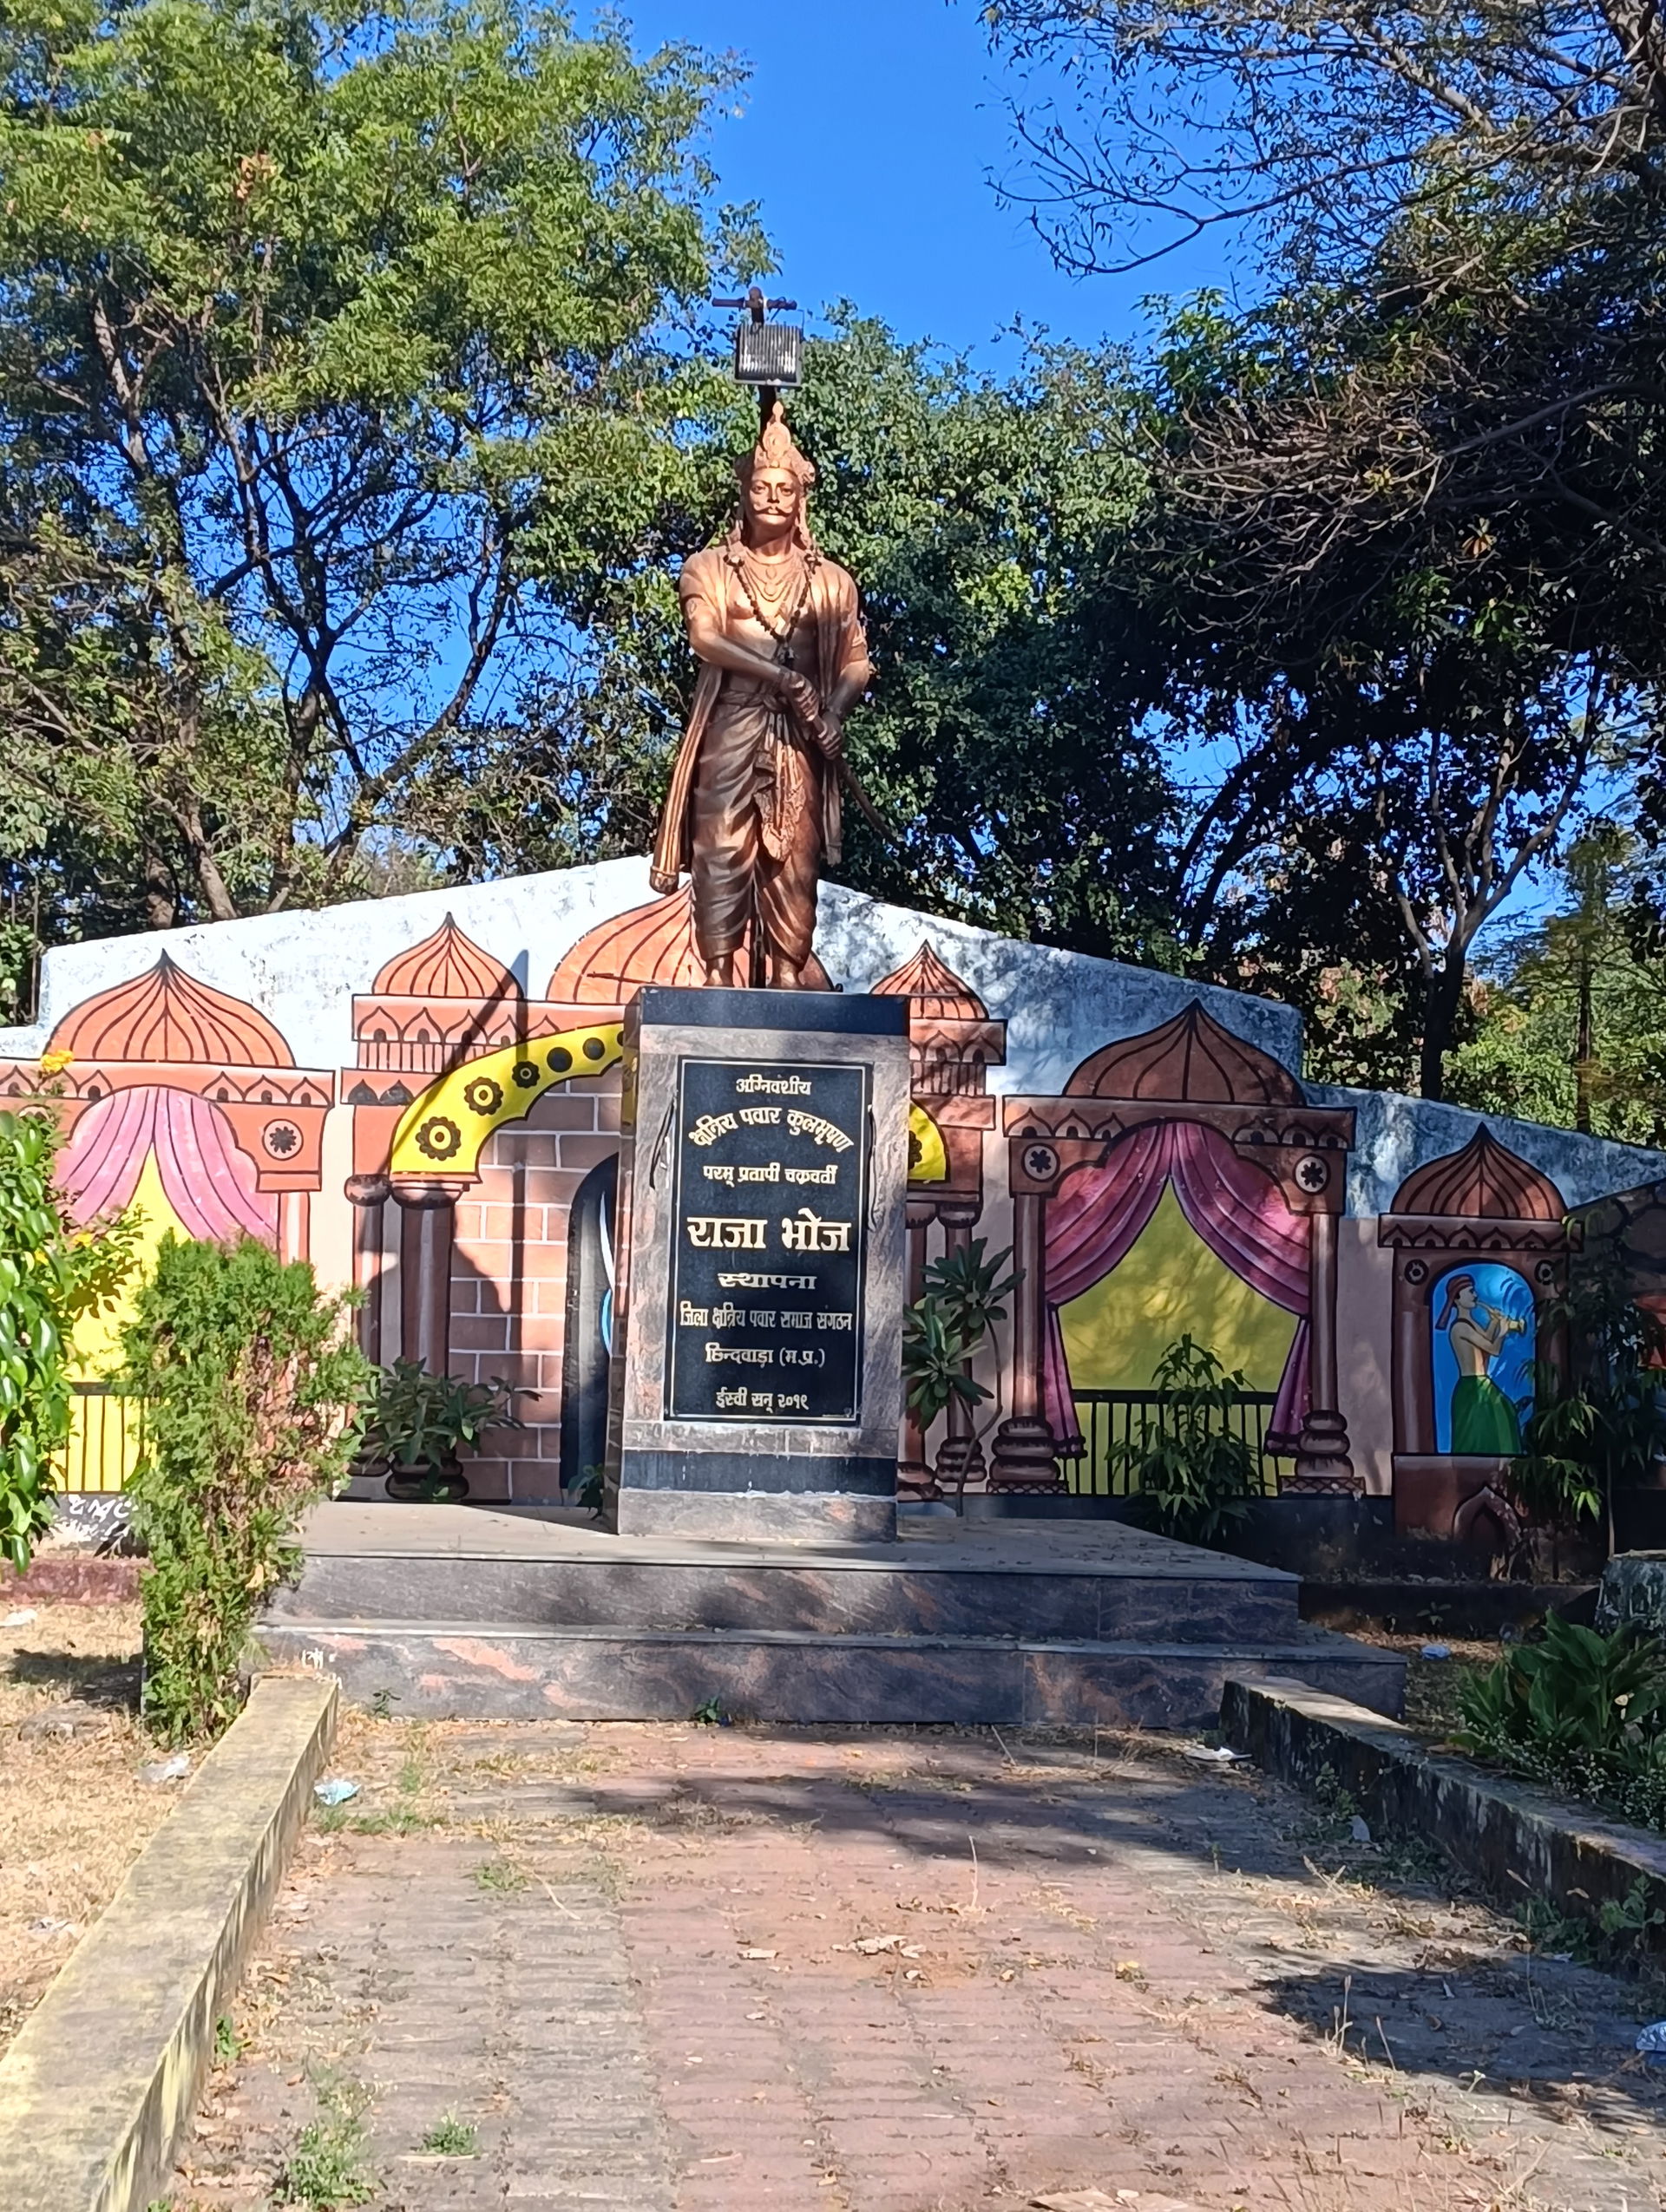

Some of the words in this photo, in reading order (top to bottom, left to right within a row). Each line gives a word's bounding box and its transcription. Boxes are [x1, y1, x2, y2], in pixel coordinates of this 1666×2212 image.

[688, 1114, 738, 1146] क्षत्रिय
[739, 1107, 783, 1125] पवार
[787, 1109, 855, 1153] कुलभूषण
[738, 1162, 781, 1182] प्रतापी
[686, 1216, 768, 1248] राजा
[781, 1207, 852, 1251] भोज
[717, 1273, 817, 1289] स्थापना
[679, 1300, 709, 1326] जिला
[712, 1302, 746, 1330] क्षत्रिय
[750, 1310, 777, 1328] पवार
[780, 1311, 813, 1329] समाज
[705, 1342, 774, 1368] छिन्दवाड़ा
[716, 1386, 747, 1408] ईस्वी
[751, 1393, 773, 1413] सन्
[777, 1394, 810, 1410] २०१९
